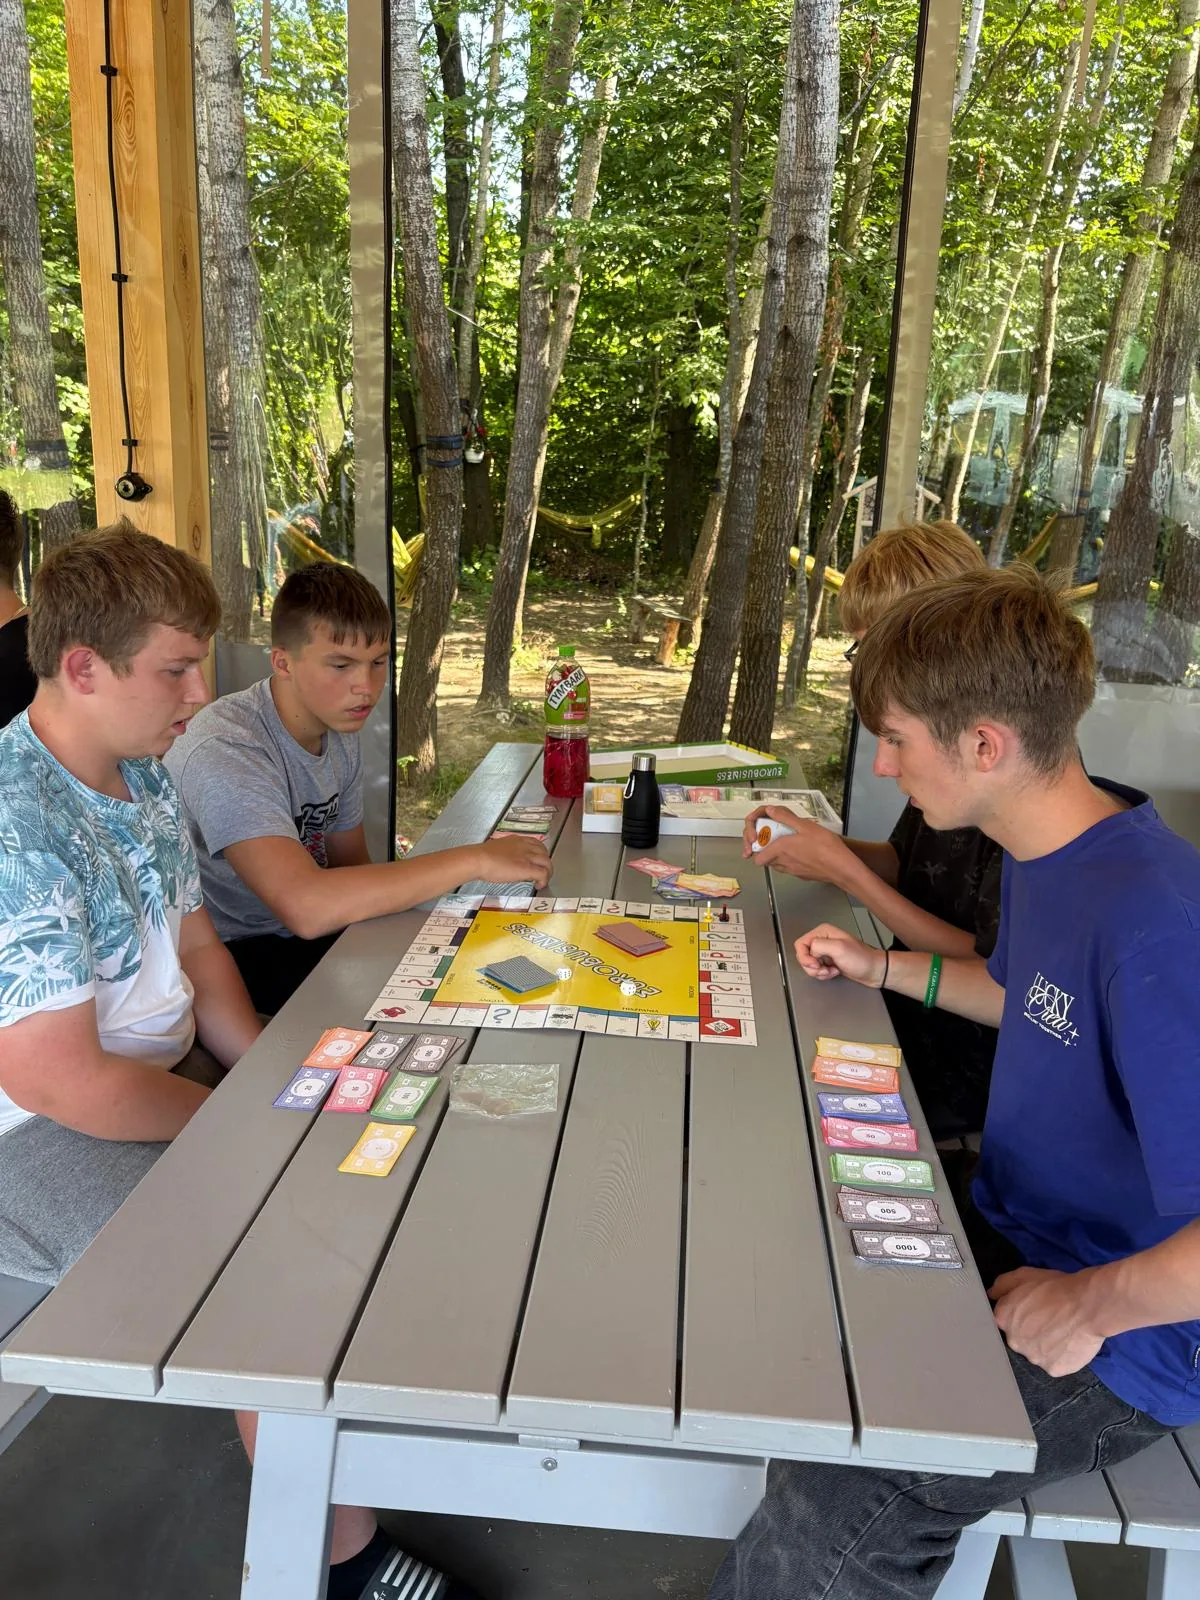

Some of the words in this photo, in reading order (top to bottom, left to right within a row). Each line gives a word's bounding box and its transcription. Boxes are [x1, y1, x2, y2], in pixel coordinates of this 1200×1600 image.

[549, 669, 584, 706] TYMBARK
[716, 766, 783, 781] EUROBUSINESS
[503, 922, 662, 999] EUROBUSINESS
[1024, 985, 1073, 1032] Crew
[1028, 972, 1075, 1020] LUCKY
